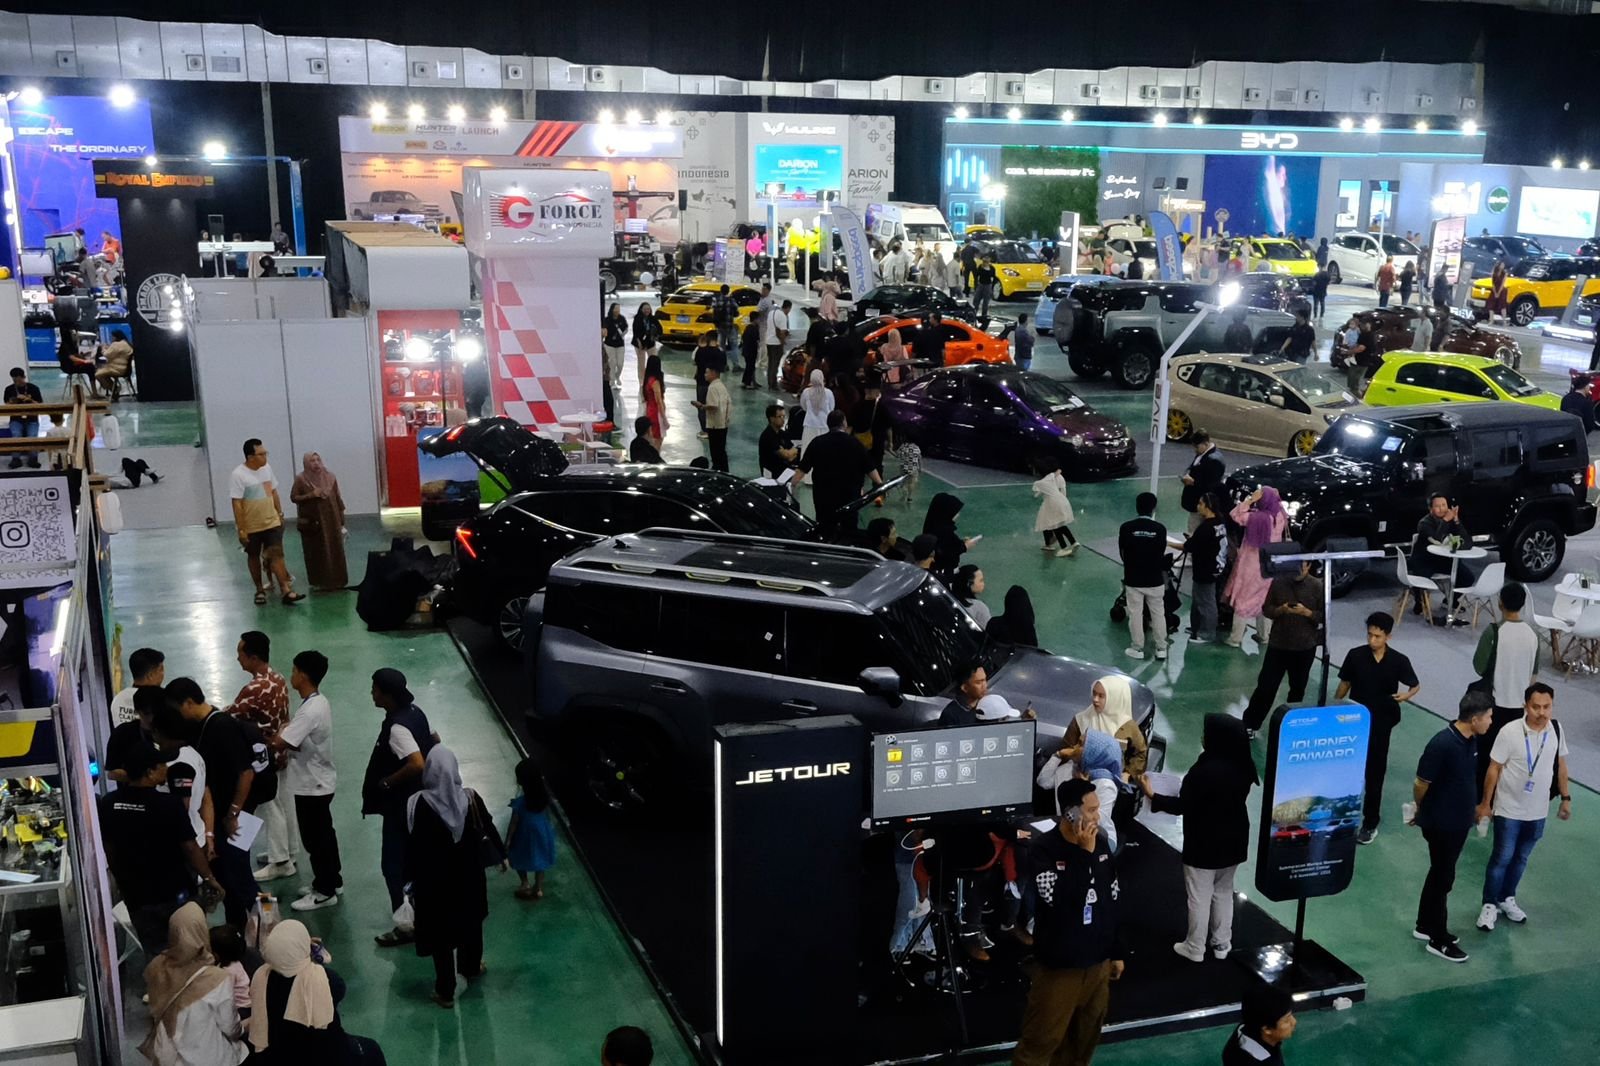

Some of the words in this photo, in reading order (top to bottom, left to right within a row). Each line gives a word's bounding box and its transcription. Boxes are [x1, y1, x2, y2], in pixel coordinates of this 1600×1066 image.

[18, 127, 74, 135] ESCAPE
[416, 124, 457, 132] HUNTER
[462, 127, 499, 136] LAUNCH
[1241, 133, 1298, 149] BYD
[50, 145, 78, 153] THE
[79, 145, 147, 153] ORDINARY
[501, 196, 535, 229] G
[540, 204, 602, 219] FORCE
[1292, 735, 1358, 749] JOURNEY
[1288, 748, 1354, 762] ONWARD
[736, 762, 851, 785] JETOUR
